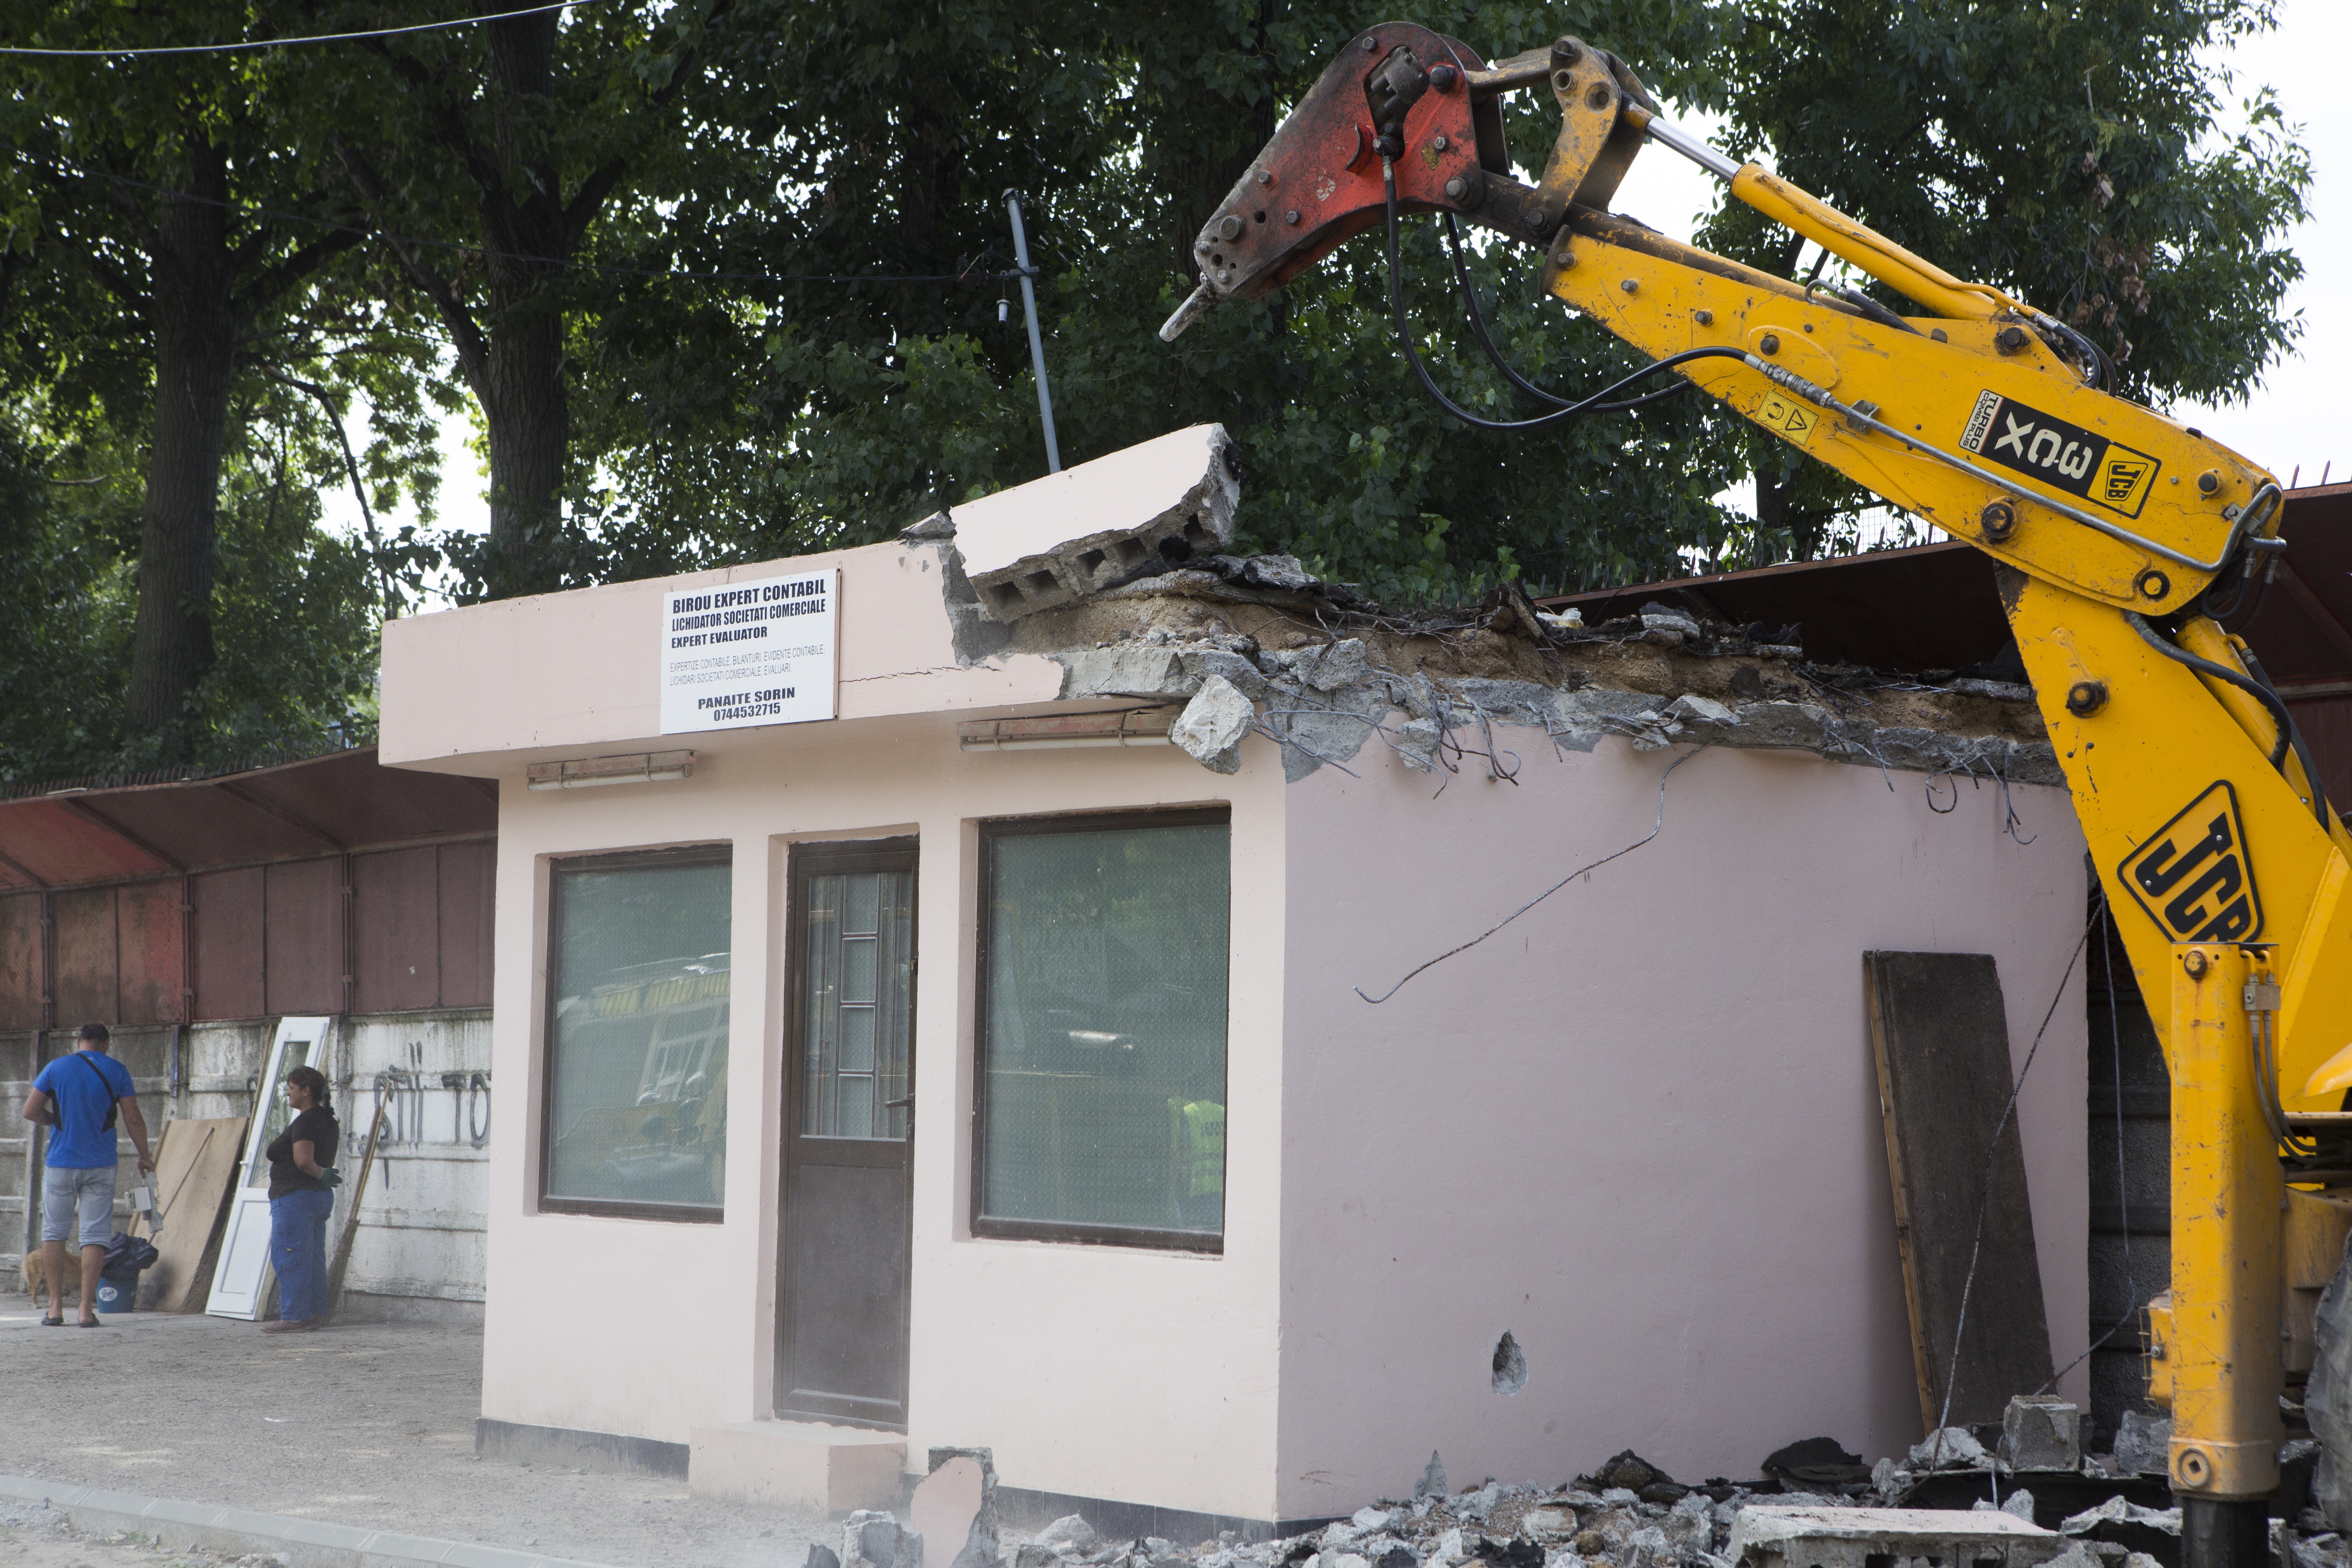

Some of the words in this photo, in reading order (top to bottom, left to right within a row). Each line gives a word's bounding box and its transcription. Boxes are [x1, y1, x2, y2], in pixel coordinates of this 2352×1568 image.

[1973, 392, 1989, 422] COMBI
[1963, 423, 1976, 447] PLUS
[1969, 397, 1999, 450] TURBO
[1994, 411, 2092, 479] 3CX
[2108, 465, 2141, 499] JCB
[673, 595, 711, 614] BIROU
[714, 588, 760, 608] EXPERT
[763, 579, 826, 602] CONTABIL
[672, 613, 721, 631] LICHIDATOR
[724, 606, 767, 625] SOCIETATI
[770, 599, 826, 619] COMERCIALE
[671, 634, 707, 649] EXPERT
[710, 626, 767, 644] EVALUATOR
[671, 660, 699, 672] EXPERTIZE
[700, 656, 732, 669] CONTABILE,
[733, 652, 763, 665] BILANTURI,
[764, 649, 791, 661] EVIDENTE
[792, 644, 825, 658] CONTABILE,
[670, 675, 695, 686] LICHIDARI
[697, 671, 724, 683] SOCIETATI
[725, 666, 763, 680] COMERCIALE,
[764, 663, 792, 676] EVALUARI.
[698, 692, 751, 710] PANAITE
[754, 687, 795, 702] SORIN
[714, 702, 780, 721] 0744532715
